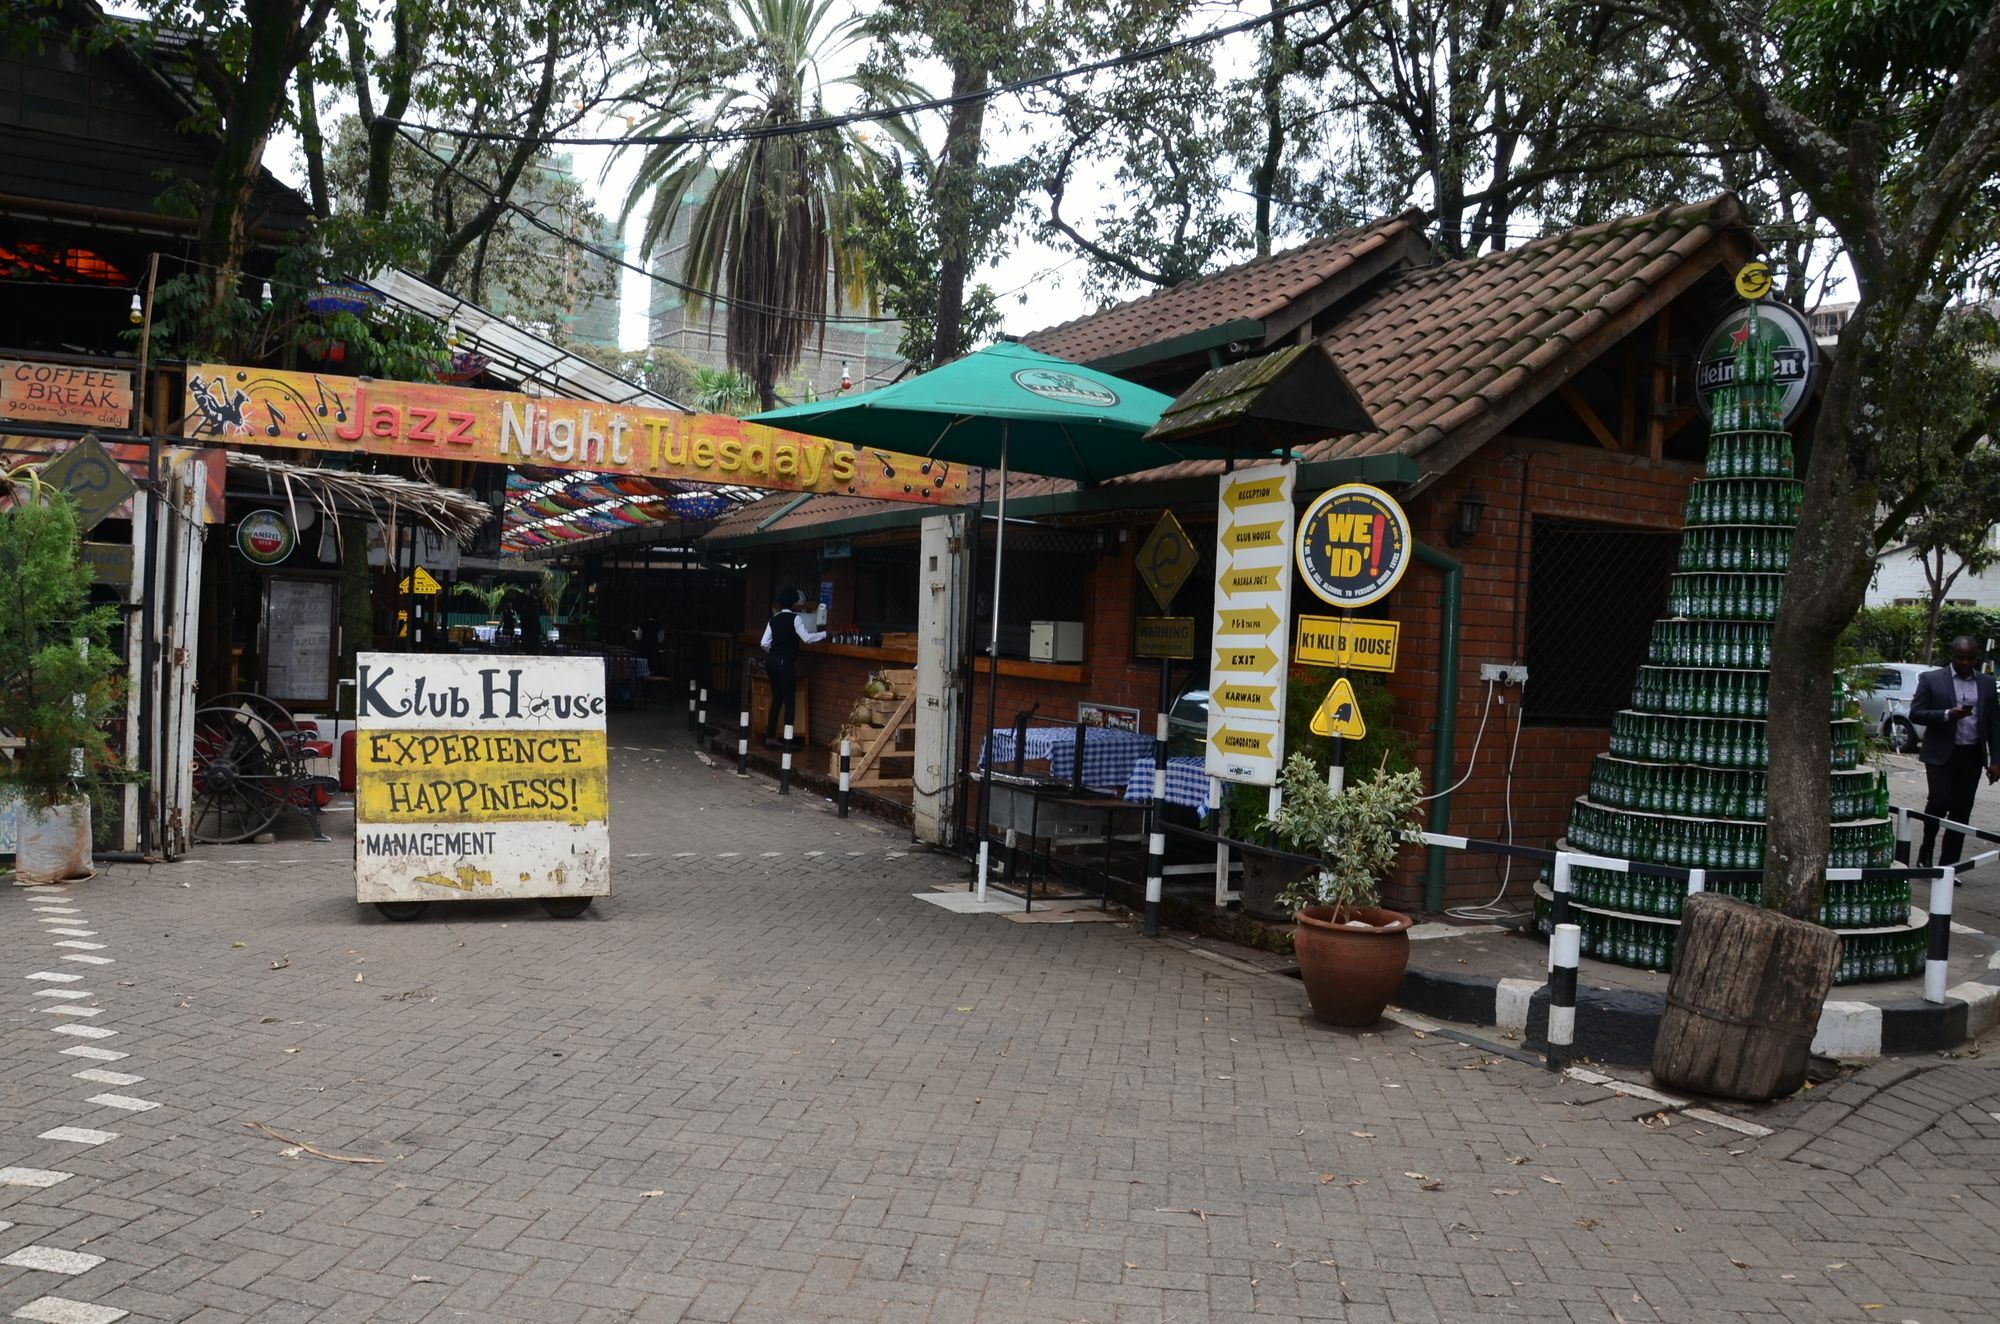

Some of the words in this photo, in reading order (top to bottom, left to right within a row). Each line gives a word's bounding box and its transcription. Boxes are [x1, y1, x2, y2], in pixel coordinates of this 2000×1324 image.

[15, 364, 118, 388] COFFEE
[1700, 358, 1798, 385] Heinen
[26, 383, 119, 409] BREAK
[97, 409, 122, 427] daily
[335, 387, 476, 444] Jazz
[499, 401, 629, 464] Night
[642, 416, 855, 487] Tuesday's
[1238, 488, 1270, 500] RECEPTION
[1236, 533, 1252, 542] KLUB
[1252, 530, 1271, 541] HOUSE
[1328, 513, 1373, 544] WE
[1232, 577, 1252, 586] MASALA
[1140, 625, 1189, 639] WARNING
[1302, 632, 1315, 648] K1
[1232, 655, 1256, 665] EXIT
[358, 664, 470, 719] Klub
[1225, 691, 1261, 704] KARWASH
[370, 734, 582, 766] EXPERIENCE
[387, 778, 579, 813] HAPPINESS!
[366, 832, 496, 856] MANAGEMENT
